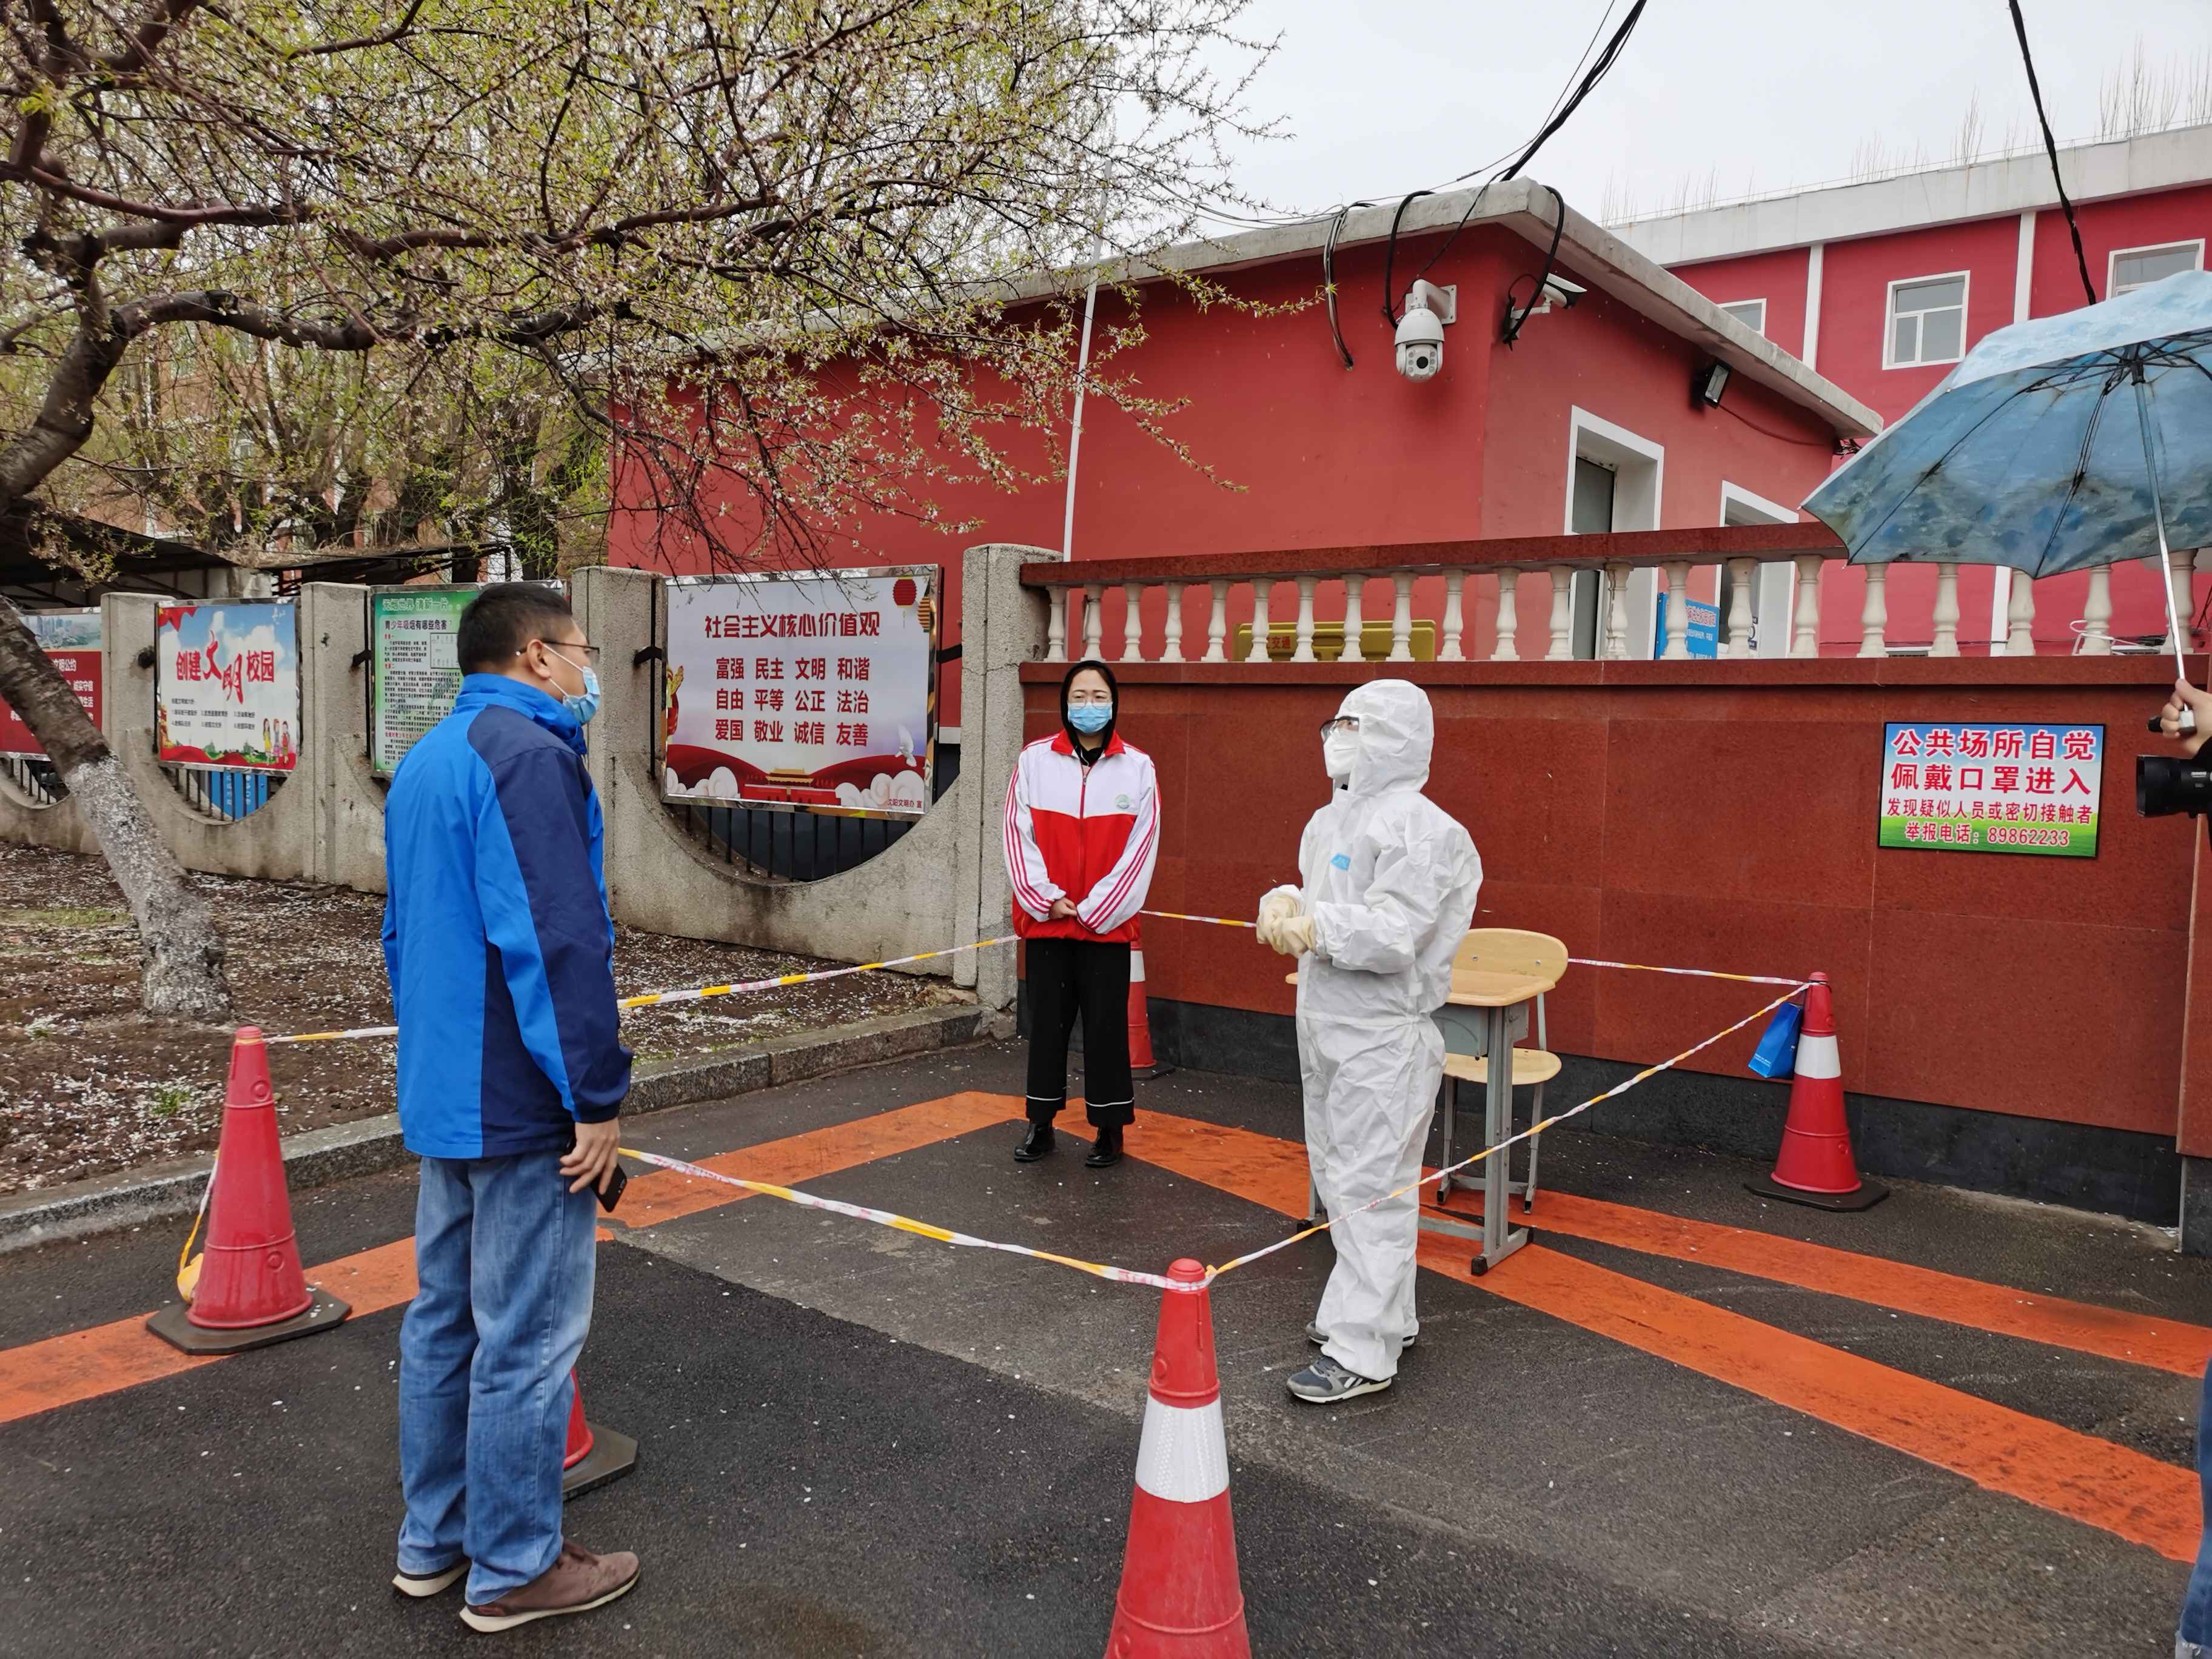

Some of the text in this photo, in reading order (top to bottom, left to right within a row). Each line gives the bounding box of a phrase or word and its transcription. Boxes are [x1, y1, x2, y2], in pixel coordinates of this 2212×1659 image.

[705, 611, 880, 638] 社会主义核心价值观
[716, 657, 870, 681] 富强 民主 文明 和谐
[716, 688, 869, 714] 自由 平等 公正 法治
[716, 719, 868, 746] 爱国 敬业 诚信 友善
[1892, 729, 2094, 760] 公共场所自觉
[1891, 763, 2091, 795] 佩戴口罩进入
[1887, 797, 2093, 825] 发现疑似人员或密切接触者
[1906, 822, 2070, 846] 举报电话:89862233
